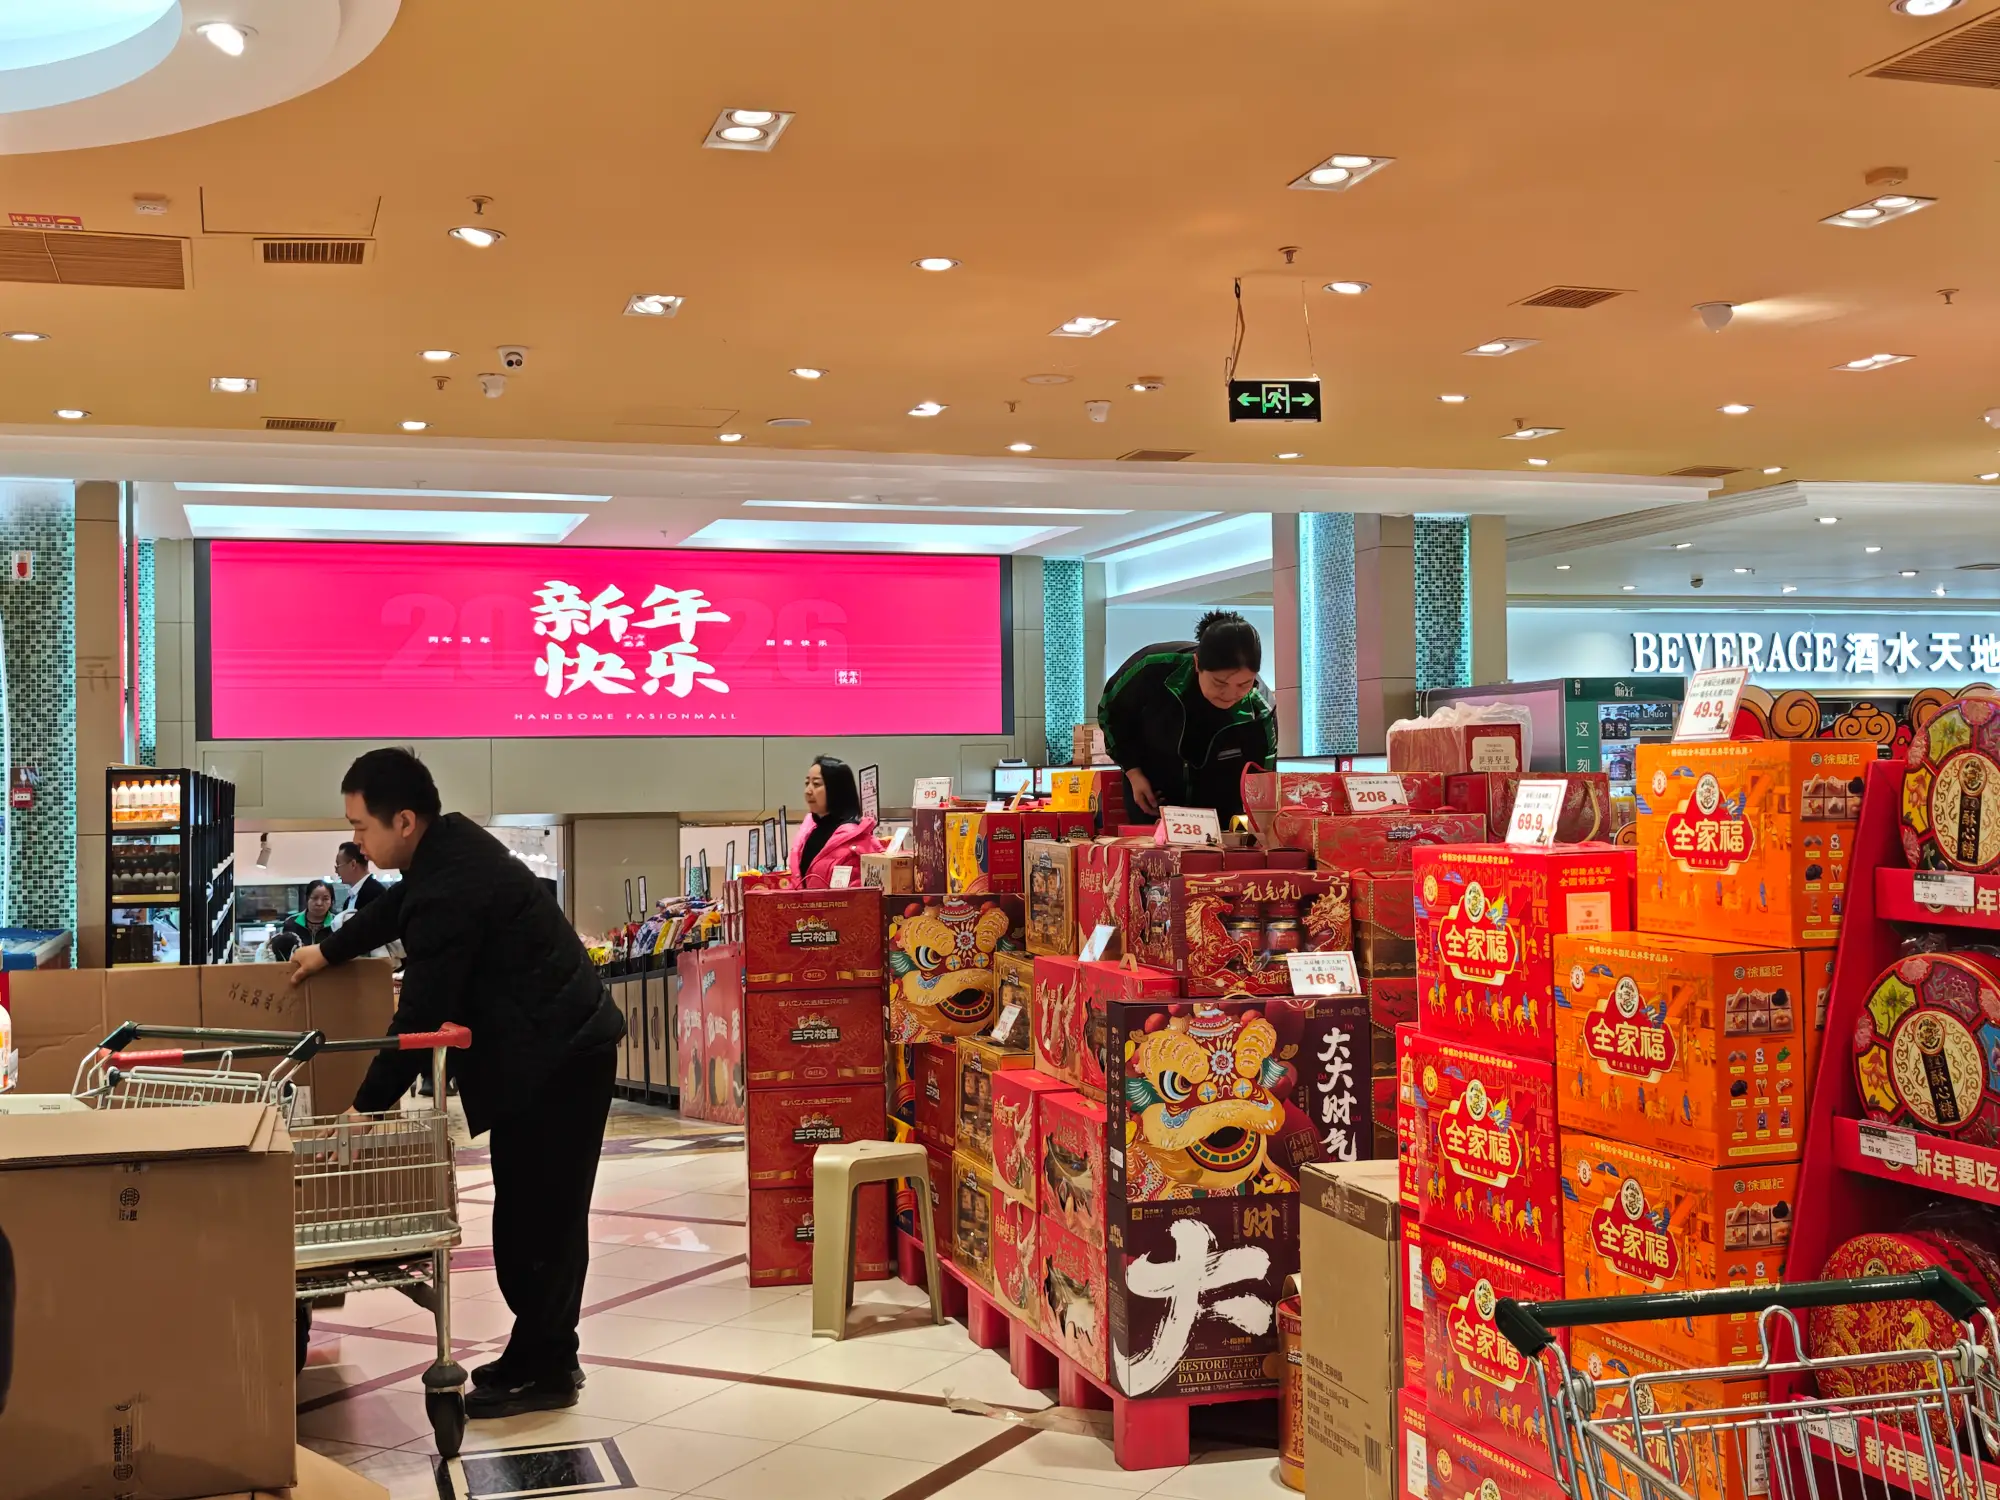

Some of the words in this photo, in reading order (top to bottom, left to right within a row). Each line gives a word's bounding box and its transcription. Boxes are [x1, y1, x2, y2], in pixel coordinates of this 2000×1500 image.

[529, 580, 731, 643] 新年
[1633, 631, 1838, 673] BEVERAGE
[1844, 632, 2000, 674] 酒水天地
[533, 641, 731, 698] 快乐
[514, 712, 616, 721] HANDSOME
[625, 712, 738, 721] FASIONMALL
[1693, 700, 1724, 718] 49.9
[1575, 721, 1590, 773] 这一刻
[924, 790, 937, 799] 99
[1356, 791, 1387, 803] 208
[1172, 823, 1202, 836] 238
[1517, 813, 1543, 831] 69.9
[1672, 818, 1745, 853] 全家福
[790, 931, 838, 943] 三只松鼠
[1445, 924, 1508, 963] 全家福
[1306, 973, 1337, 985] 168
[791, 1028, 839, 1041] 三只松鼠
[1591, 1018, 1666, 1061] 全家福
[1317, 1027, 1358, 1162] 大大财气
[794, 1127, 841, 1140] 三只松鼠
[1445, 1119, 1512, 1167] 全家福
[1243, 1202, 1280, 1240] 财
[1598, 1217, 1669, 1270] 全家福
[1178, 1359, 1228, 1372] BESTORE
[1178, 1373, 1194, 1384] DA
[1196, 1372, 1211, 1382] DA
